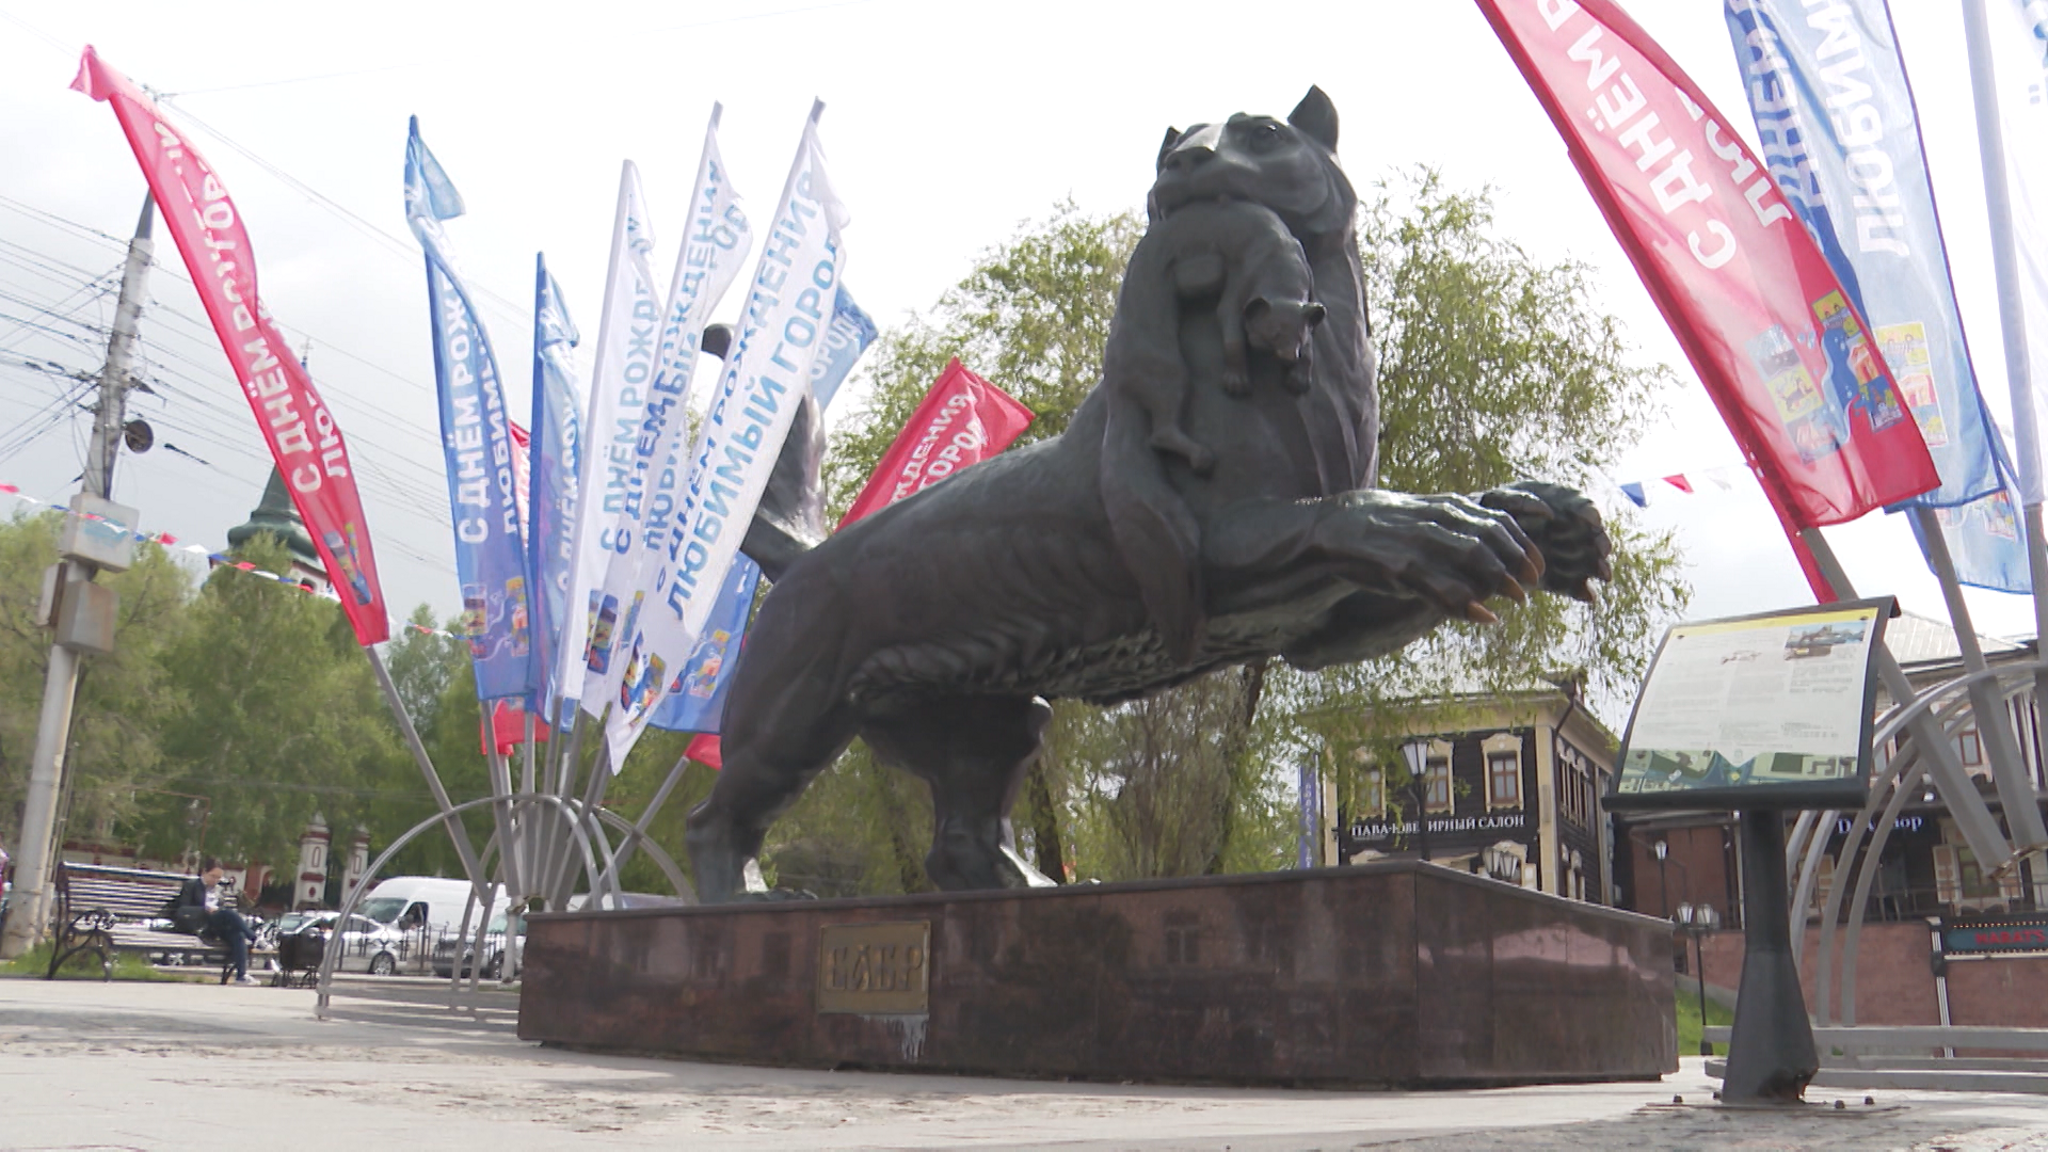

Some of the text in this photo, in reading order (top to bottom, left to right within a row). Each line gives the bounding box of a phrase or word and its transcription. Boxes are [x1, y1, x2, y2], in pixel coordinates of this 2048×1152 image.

[1567, 25, 1712, 214] ДНЁМ
[1688, 219, 1736, 269] С
[244, 336, 322, 492] С ДНЁМ
[446, 394, 491, 508] ДНЁМ
[459, 517, 488, 544] С
[667, 374, 787, 621] ЛЮБИМЫЙ
[1351, 814, 1525, 837] ПАВА-ЮВЕИРНЫЙ САЛОН
